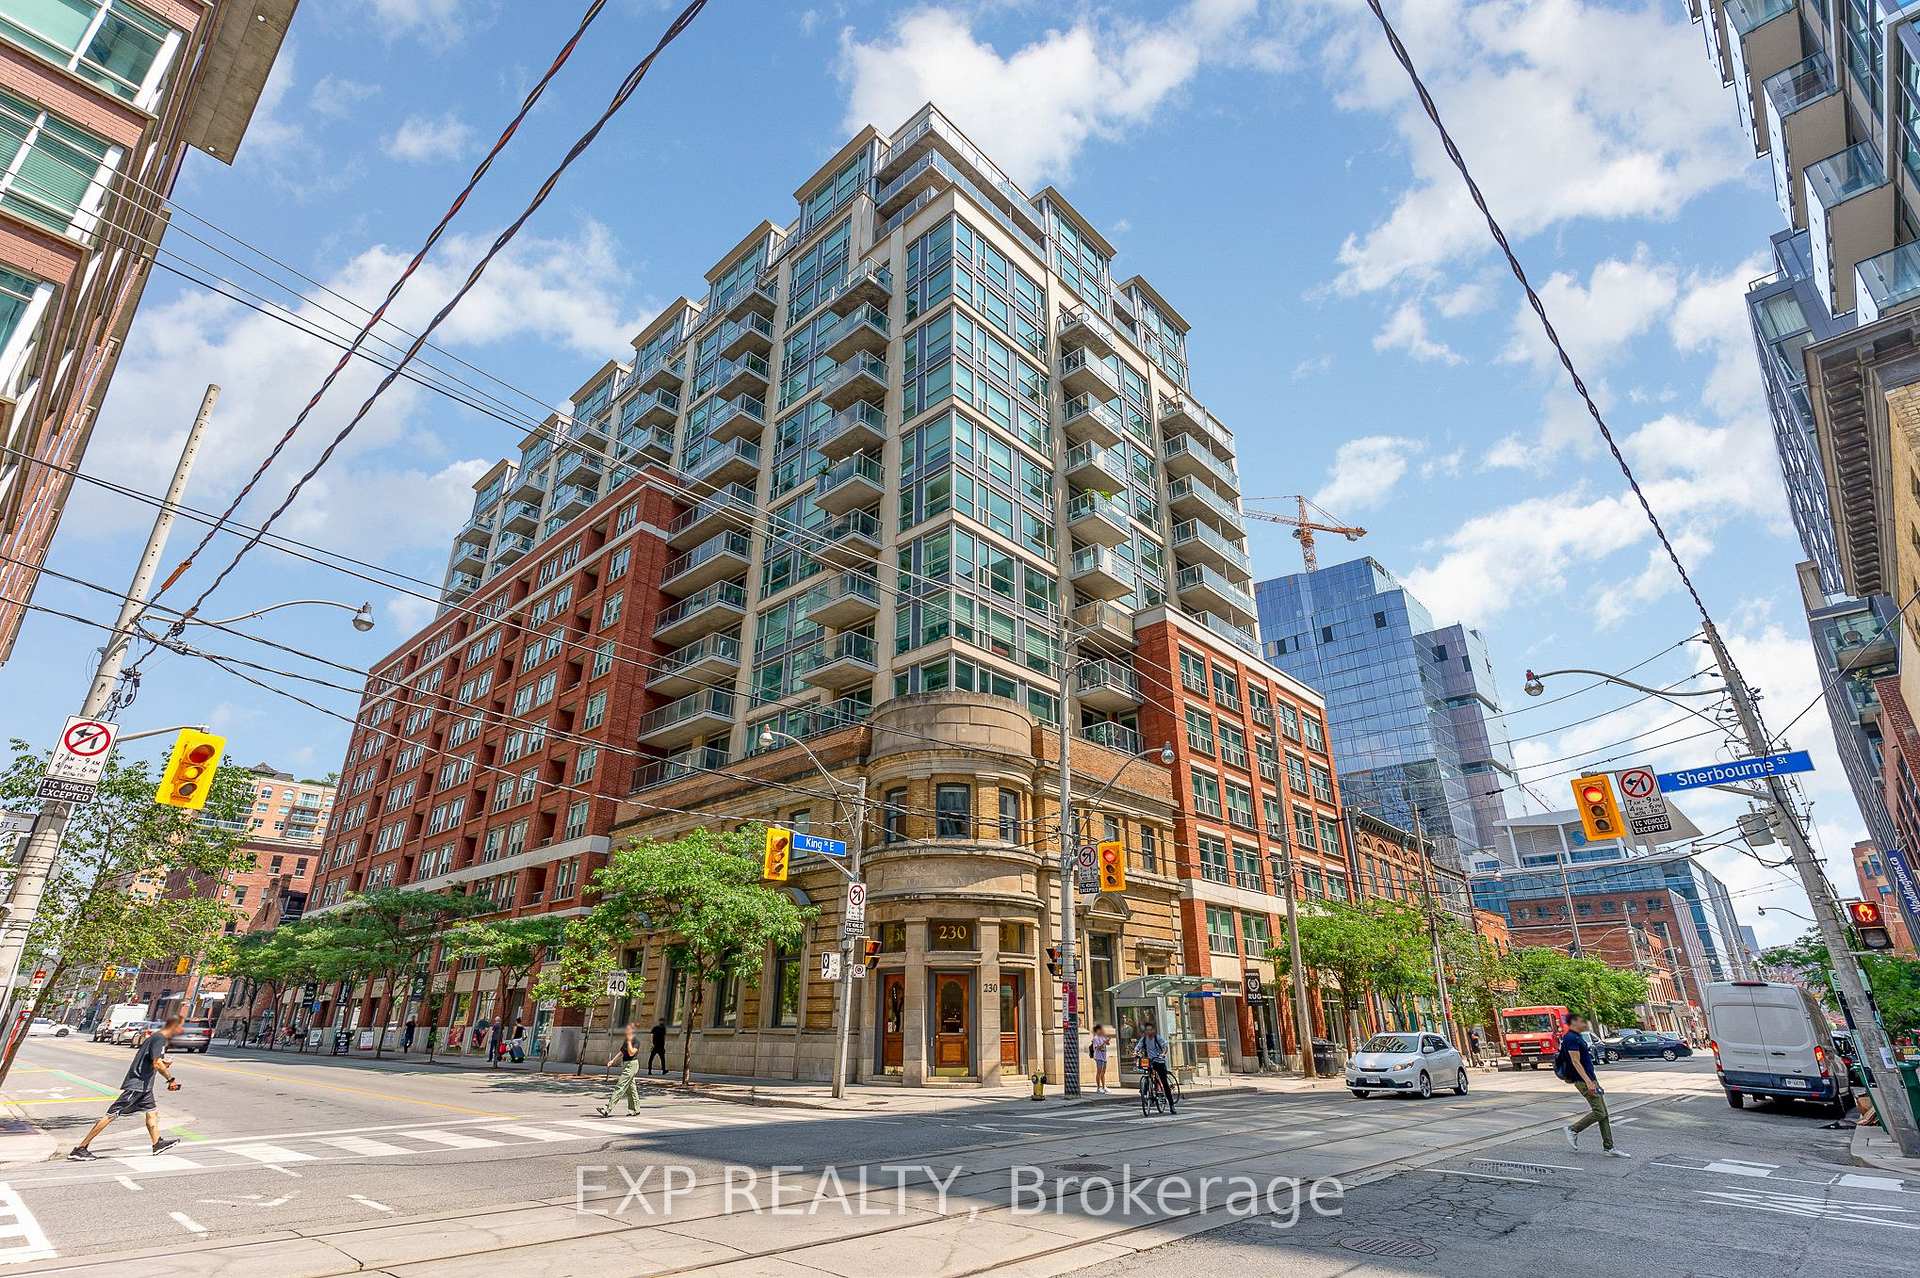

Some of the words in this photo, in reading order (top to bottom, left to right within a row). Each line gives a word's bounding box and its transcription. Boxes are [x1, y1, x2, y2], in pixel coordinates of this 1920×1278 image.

[1676, 761, 1775, 786] Sherbourne
[1776, 757, 1788, 765] St
[43, 780, 59, 789] TTC
[61, 783, 95, 794] VEHICLES
[41, 788, 89, 801] EXCEPTED
[1635, 823, 1669, 834] EXCEPTED
[806, 837, 823, 852] King
[830, 842, 835, 851] E
[1890, 856, 1920, 913] Waddingtons.ca
[939, 925, 967, 940] 230
[609, 980, 625, 992] 40
[983, 983, 998, 992] 230
